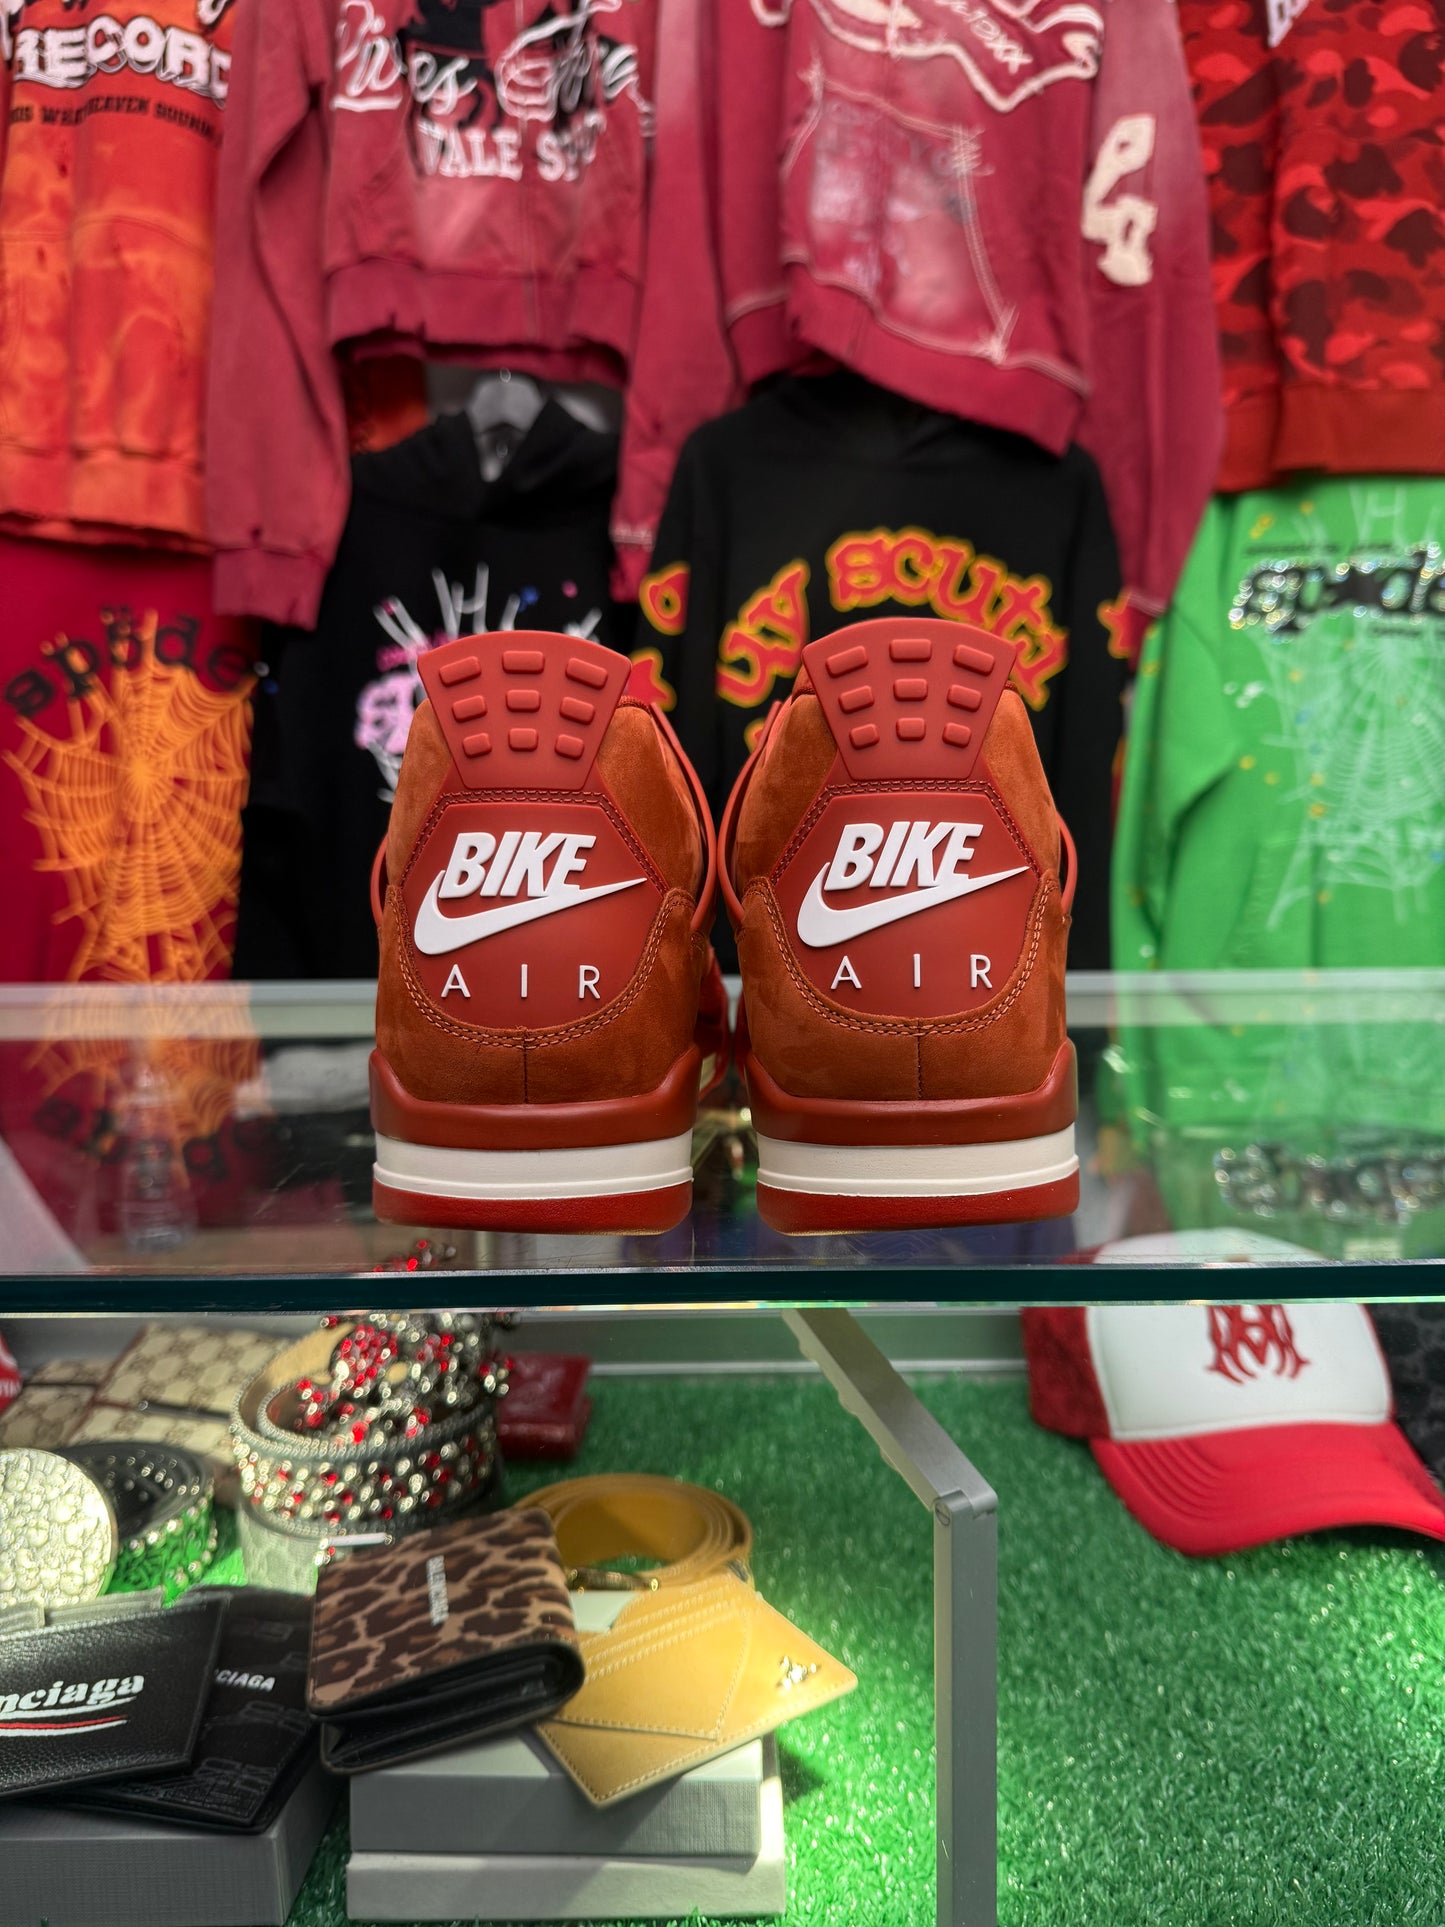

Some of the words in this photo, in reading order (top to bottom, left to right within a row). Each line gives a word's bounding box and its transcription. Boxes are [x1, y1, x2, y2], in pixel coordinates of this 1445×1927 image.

[438, 831, 597, 898] BIKE
[824, 821, 984, 892] BIKE
[440, 963, 601, 999] AIR
[830, 953, 993, 990] AIR
[214, 1669, 276, 1692] CIAGA
